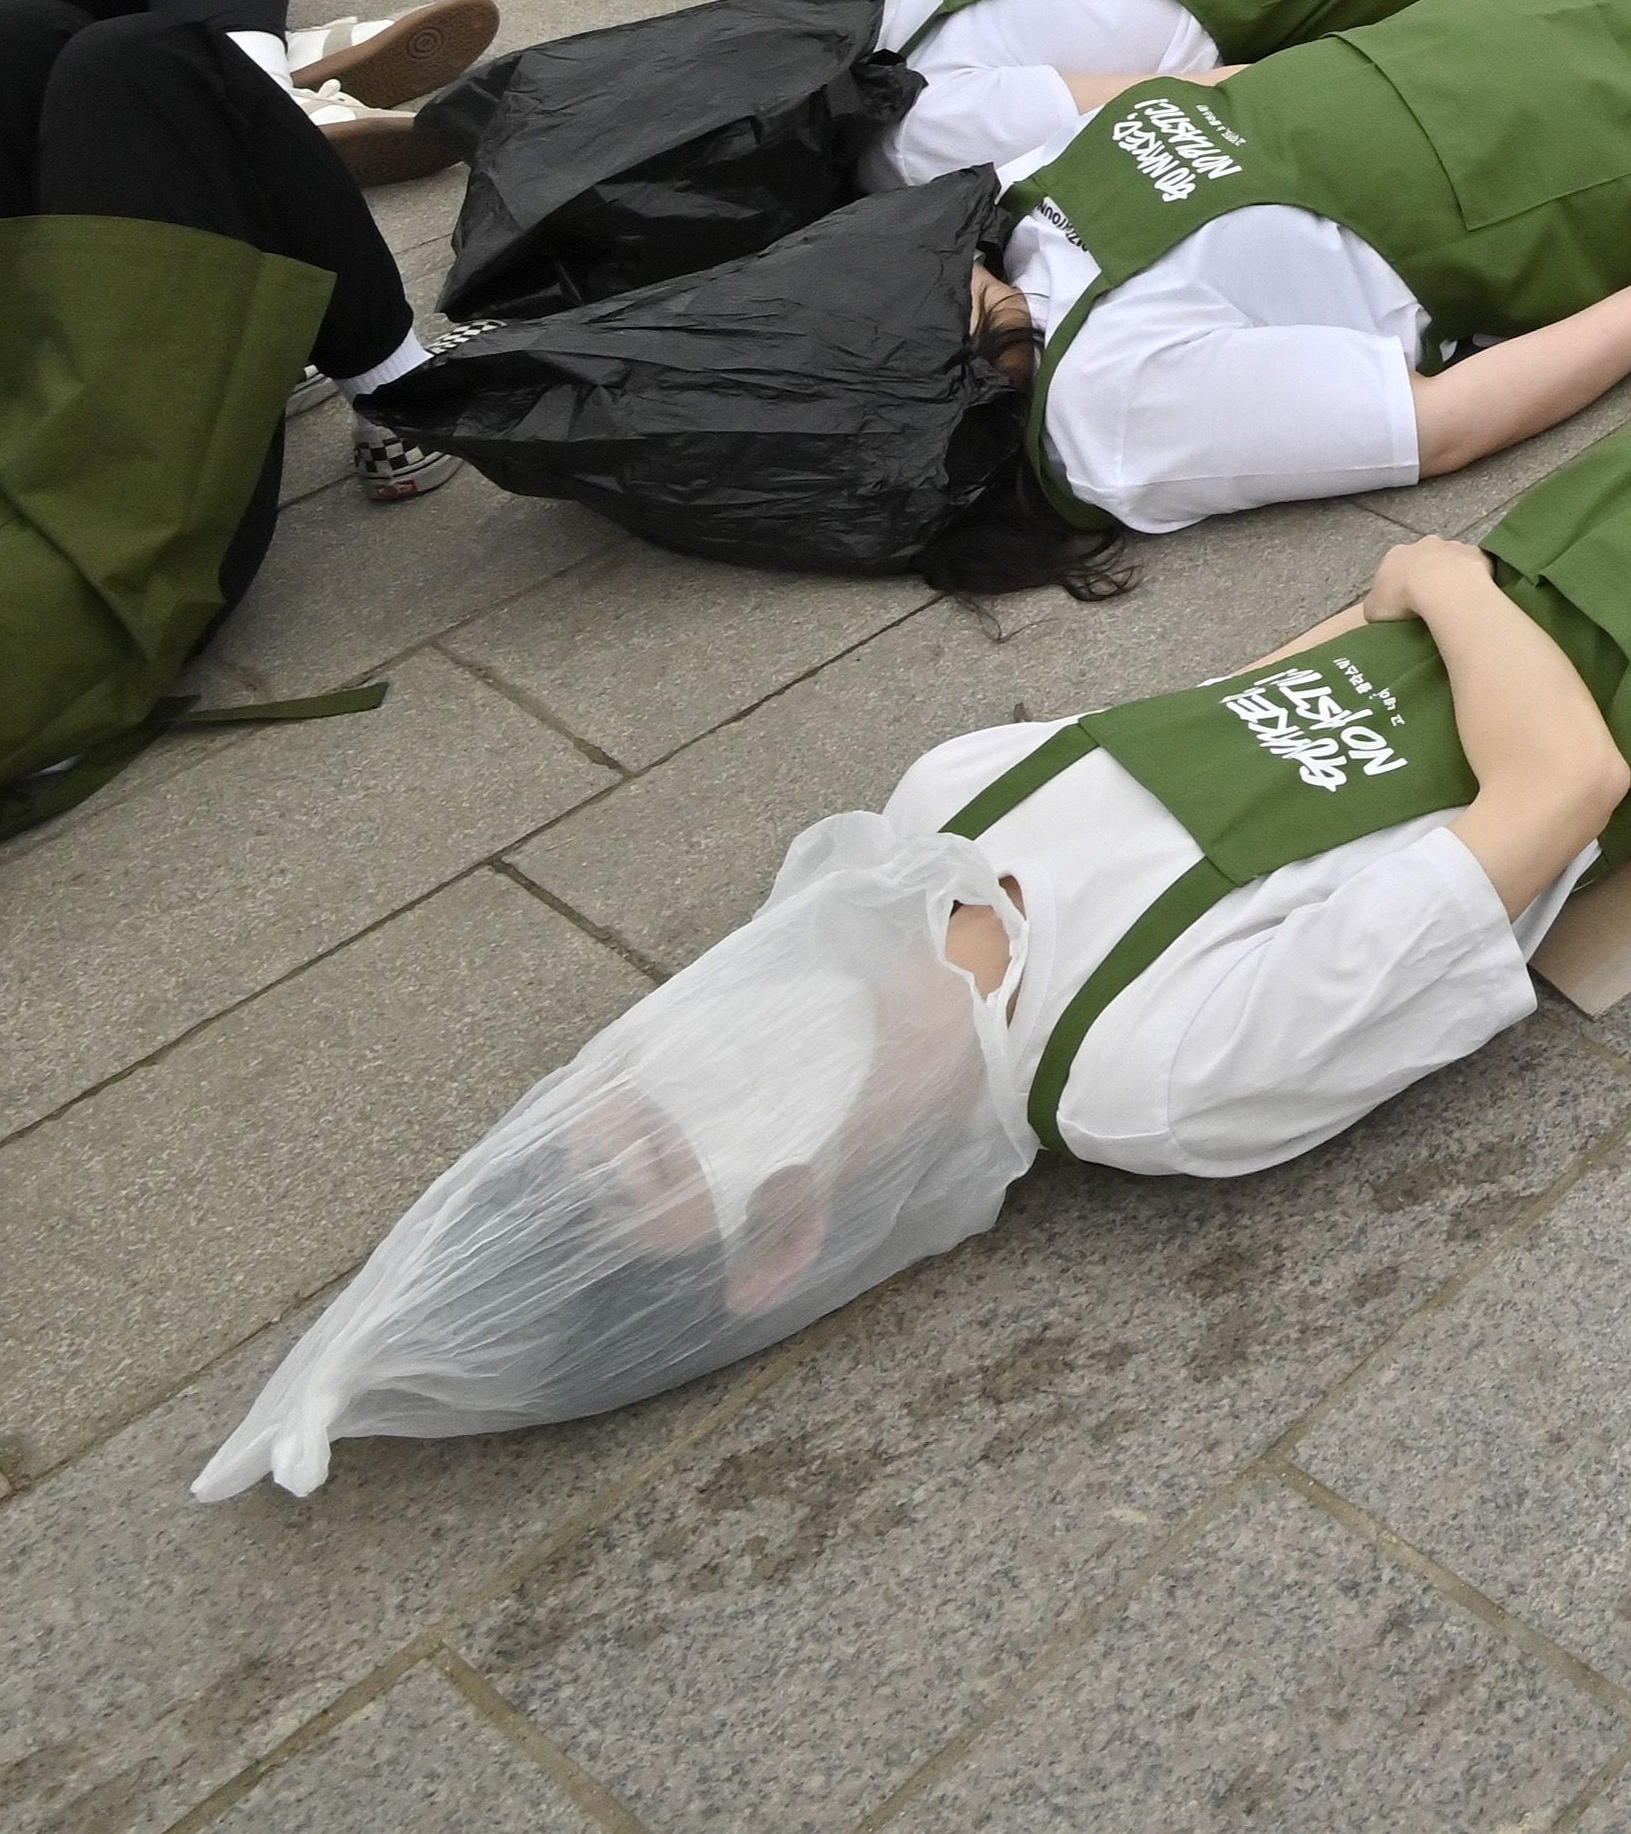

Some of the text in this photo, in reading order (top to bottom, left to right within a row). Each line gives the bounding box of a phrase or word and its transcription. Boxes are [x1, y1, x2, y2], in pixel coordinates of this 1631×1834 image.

[1134, 99, 1221, 158] PLASTIC!
[1114, 113, 1196, 202] GO NAKED,
[1191, 155, 1242, 179] NO
[1298, 738, 1348, 792] GO
[1339, 725, 1407, 776] NO
